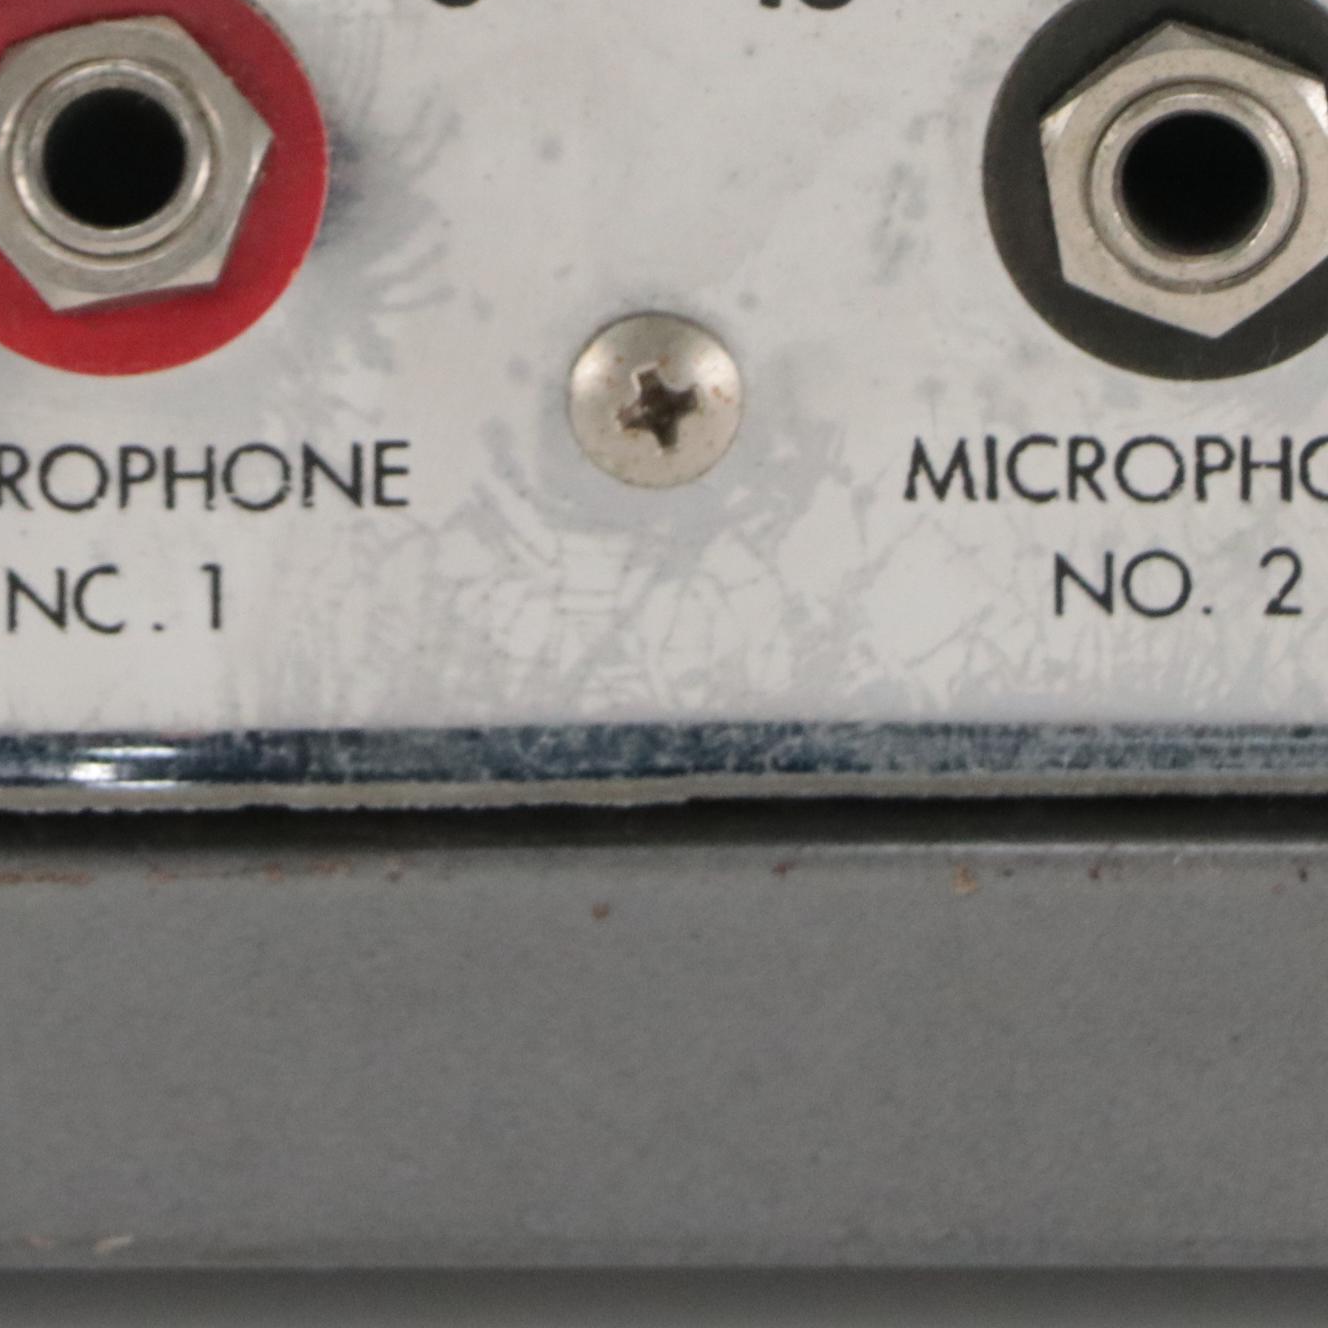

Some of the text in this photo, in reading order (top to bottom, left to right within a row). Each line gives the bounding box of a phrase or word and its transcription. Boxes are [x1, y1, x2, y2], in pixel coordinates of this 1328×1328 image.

[200, 562, 222, 630] 1
[1054, 547, 1303, 618] NO. 2
